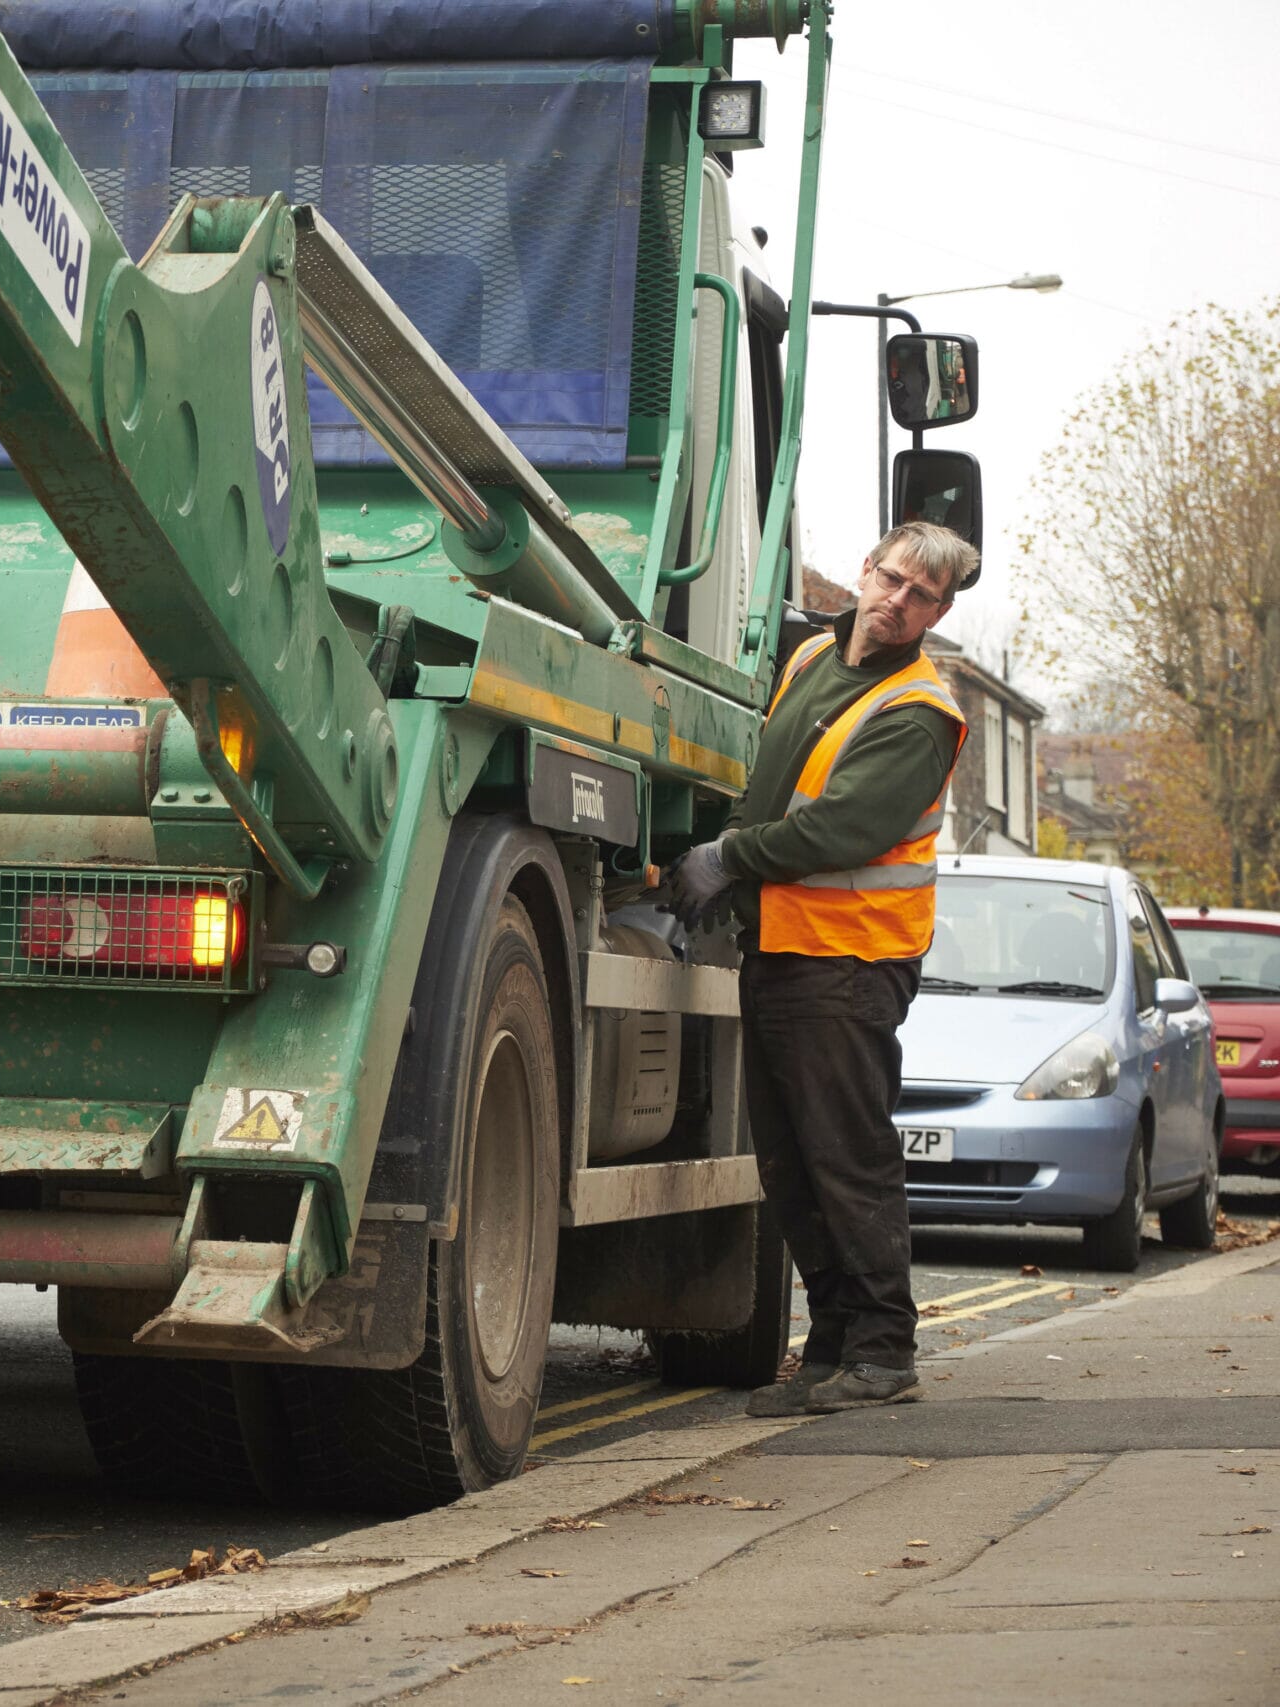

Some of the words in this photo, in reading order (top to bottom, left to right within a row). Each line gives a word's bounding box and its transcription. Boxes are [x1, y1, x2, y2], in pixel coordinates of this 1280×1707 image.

[261, 305, 289, 505] PR18
[16, 715, 66, 725] KEEP
[900, 1130, 941, 1154] ZP
